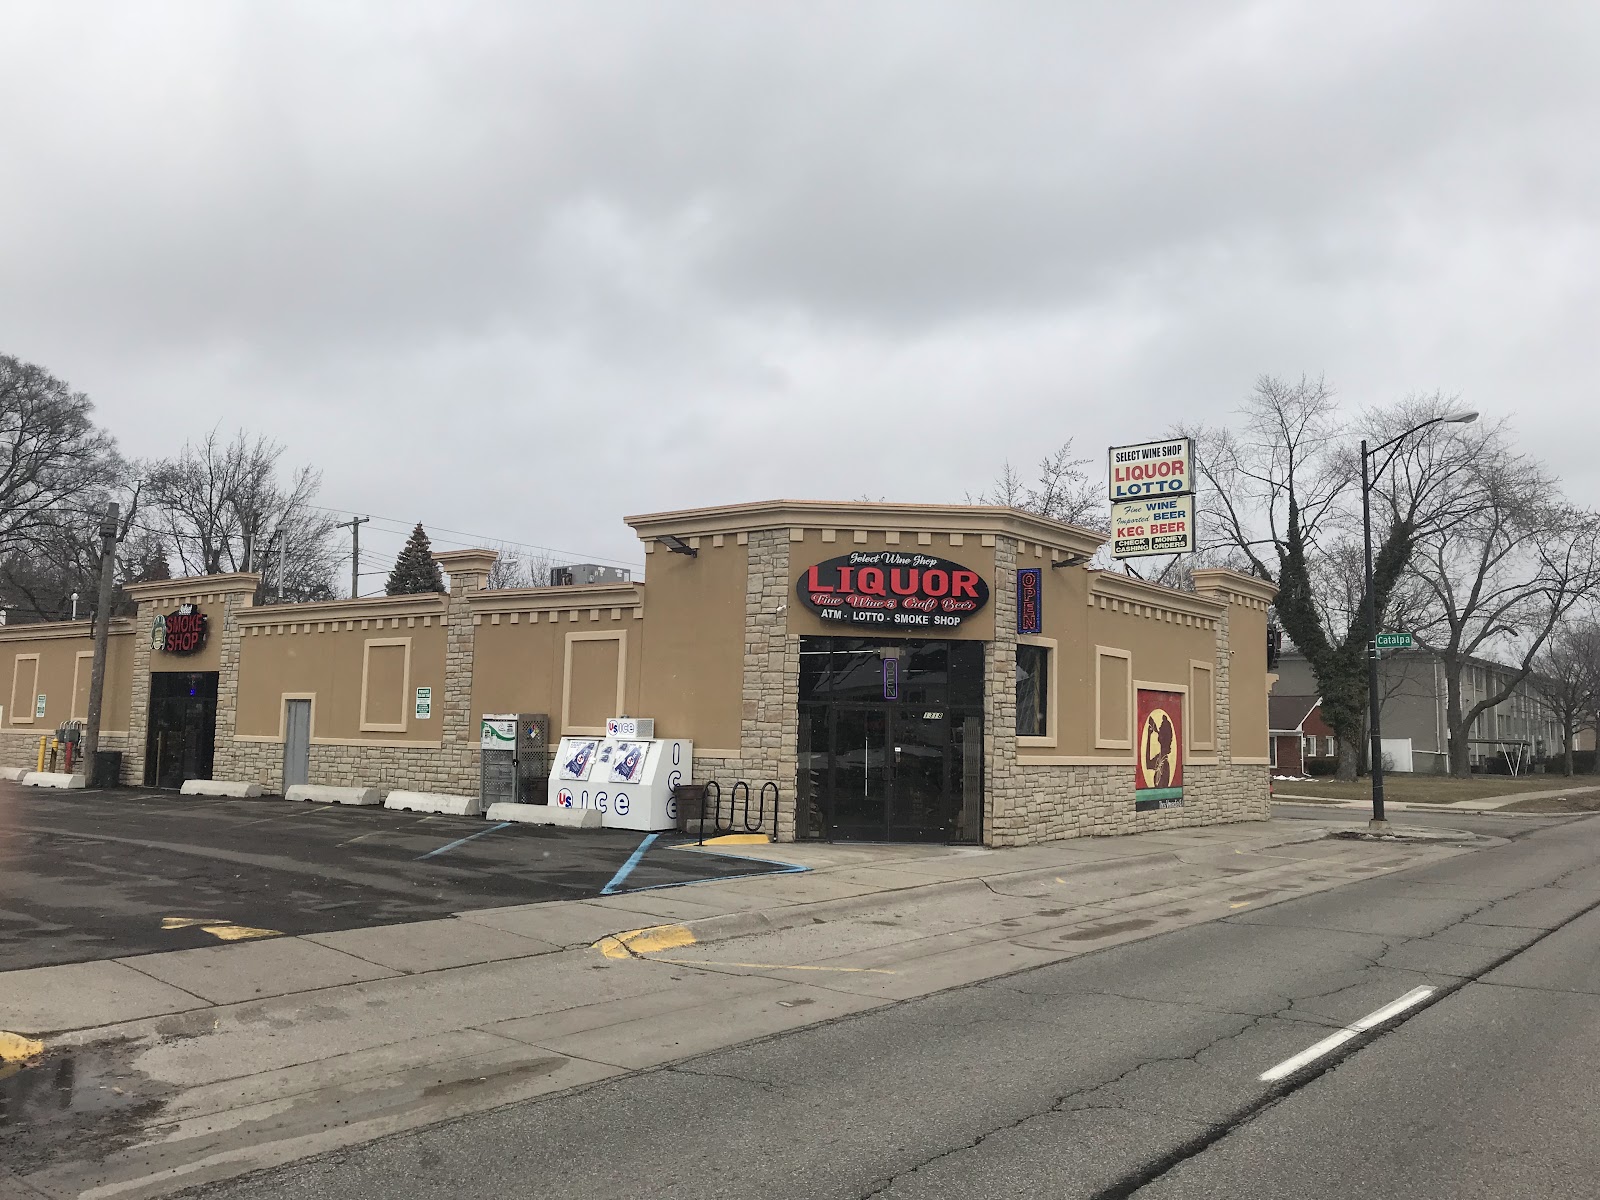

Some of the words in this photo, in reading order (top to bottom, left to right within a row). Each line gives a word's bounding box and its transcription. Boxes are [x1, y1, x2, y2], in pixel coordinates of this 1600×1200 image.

[1116, 450, 1140, 463] SELECT
[1142, 447, 1160, 459] WINE
[1162, 445, 1182, 457] SHOP
[1115, 460, 1184, 482] LIQUOR
[1116, 479, 1183, 496] LOTTO
[1123, 505, 1142, 515] Fine
[1146, 501, 1177, 511] WINE
[1116, 515, 1150, 526] Imported
[1153, 510, 1186, 521] BEER
[1117, 525, 1145, 538] KEG
[1150, 521, 1186, 535] BEER
[1115, 545, 1149, 553] CASHING
[1152, 541, 1186, 550] ORDERS
[1118, 538, 1146, 547] CHECK
[1155, 535, 1183, 544] MONEY
[850, 552, 880, 564] Select
[881, 553, 911, 565] Wine
[913, 554, 938, 567] Shop
[807, 565, 979, 598] LIQUOR
[811, 593, 843, 606] Fine
[847, 595, 884, 608] Wine
[903, 597, 937, 611] Craft
[942, 598, 975, 611] Beer
[1022, 572, 1036, 630] OPEN
[166, 613, 203, 634] SMOKE
[821, 609, 842, 620] ATM
[853, 611, 885, 623] LOTTO
[894, 613, 929, 625] SMOKE
[934, 615, 961, 626] SHOP
[167, 631, 199, 652] SHOP
[1378, 635, 1410, 645] Catalpa
